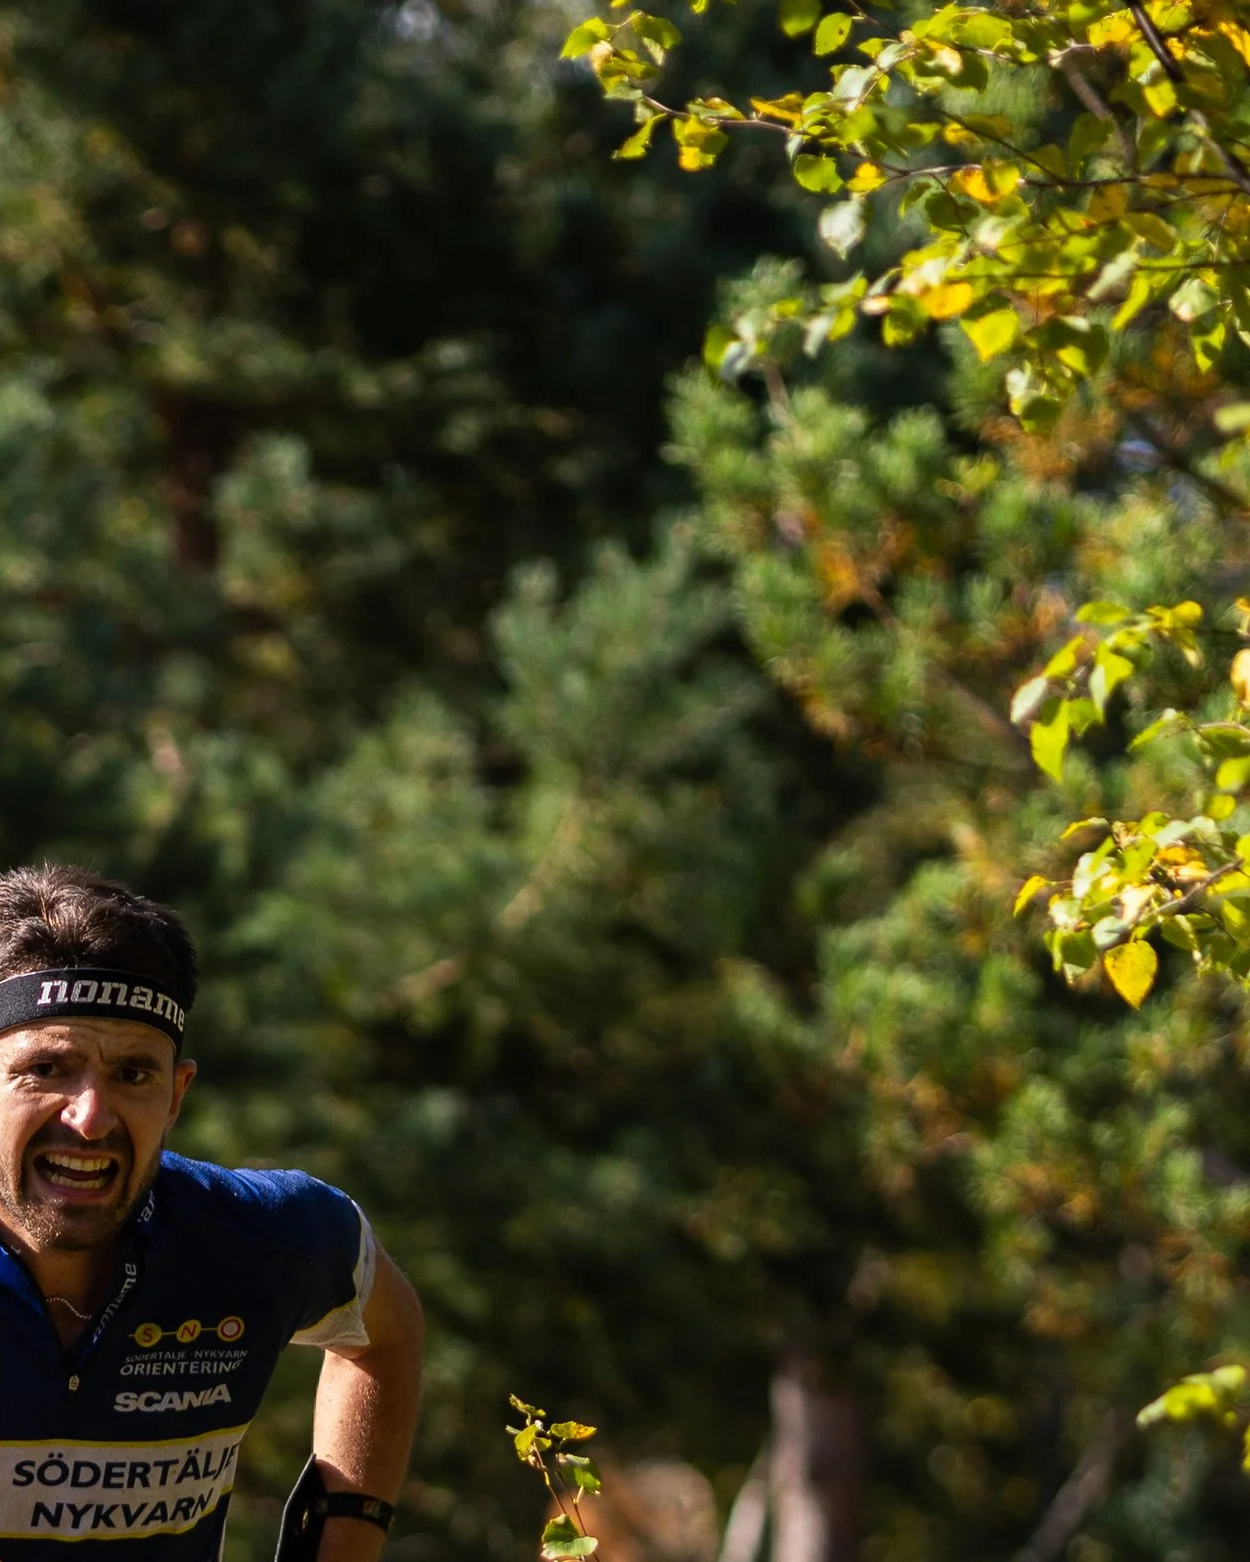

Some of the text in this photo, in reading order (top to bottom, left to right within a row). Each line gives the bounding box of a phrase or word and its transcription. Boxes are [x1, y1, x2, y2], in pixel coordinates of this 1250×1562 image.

[37, 979, 186, 1032] noname
[120, 1359, 244, 1376] ORIENTERING
[194, 1349, 248, 1359] NYKVARN
[114, 1383, 232, 1412] SCANIA
[12, 1443, 239, 1488] SÖDERTÄLJE
[30, 1488, 213, 1529] NYKVARN
